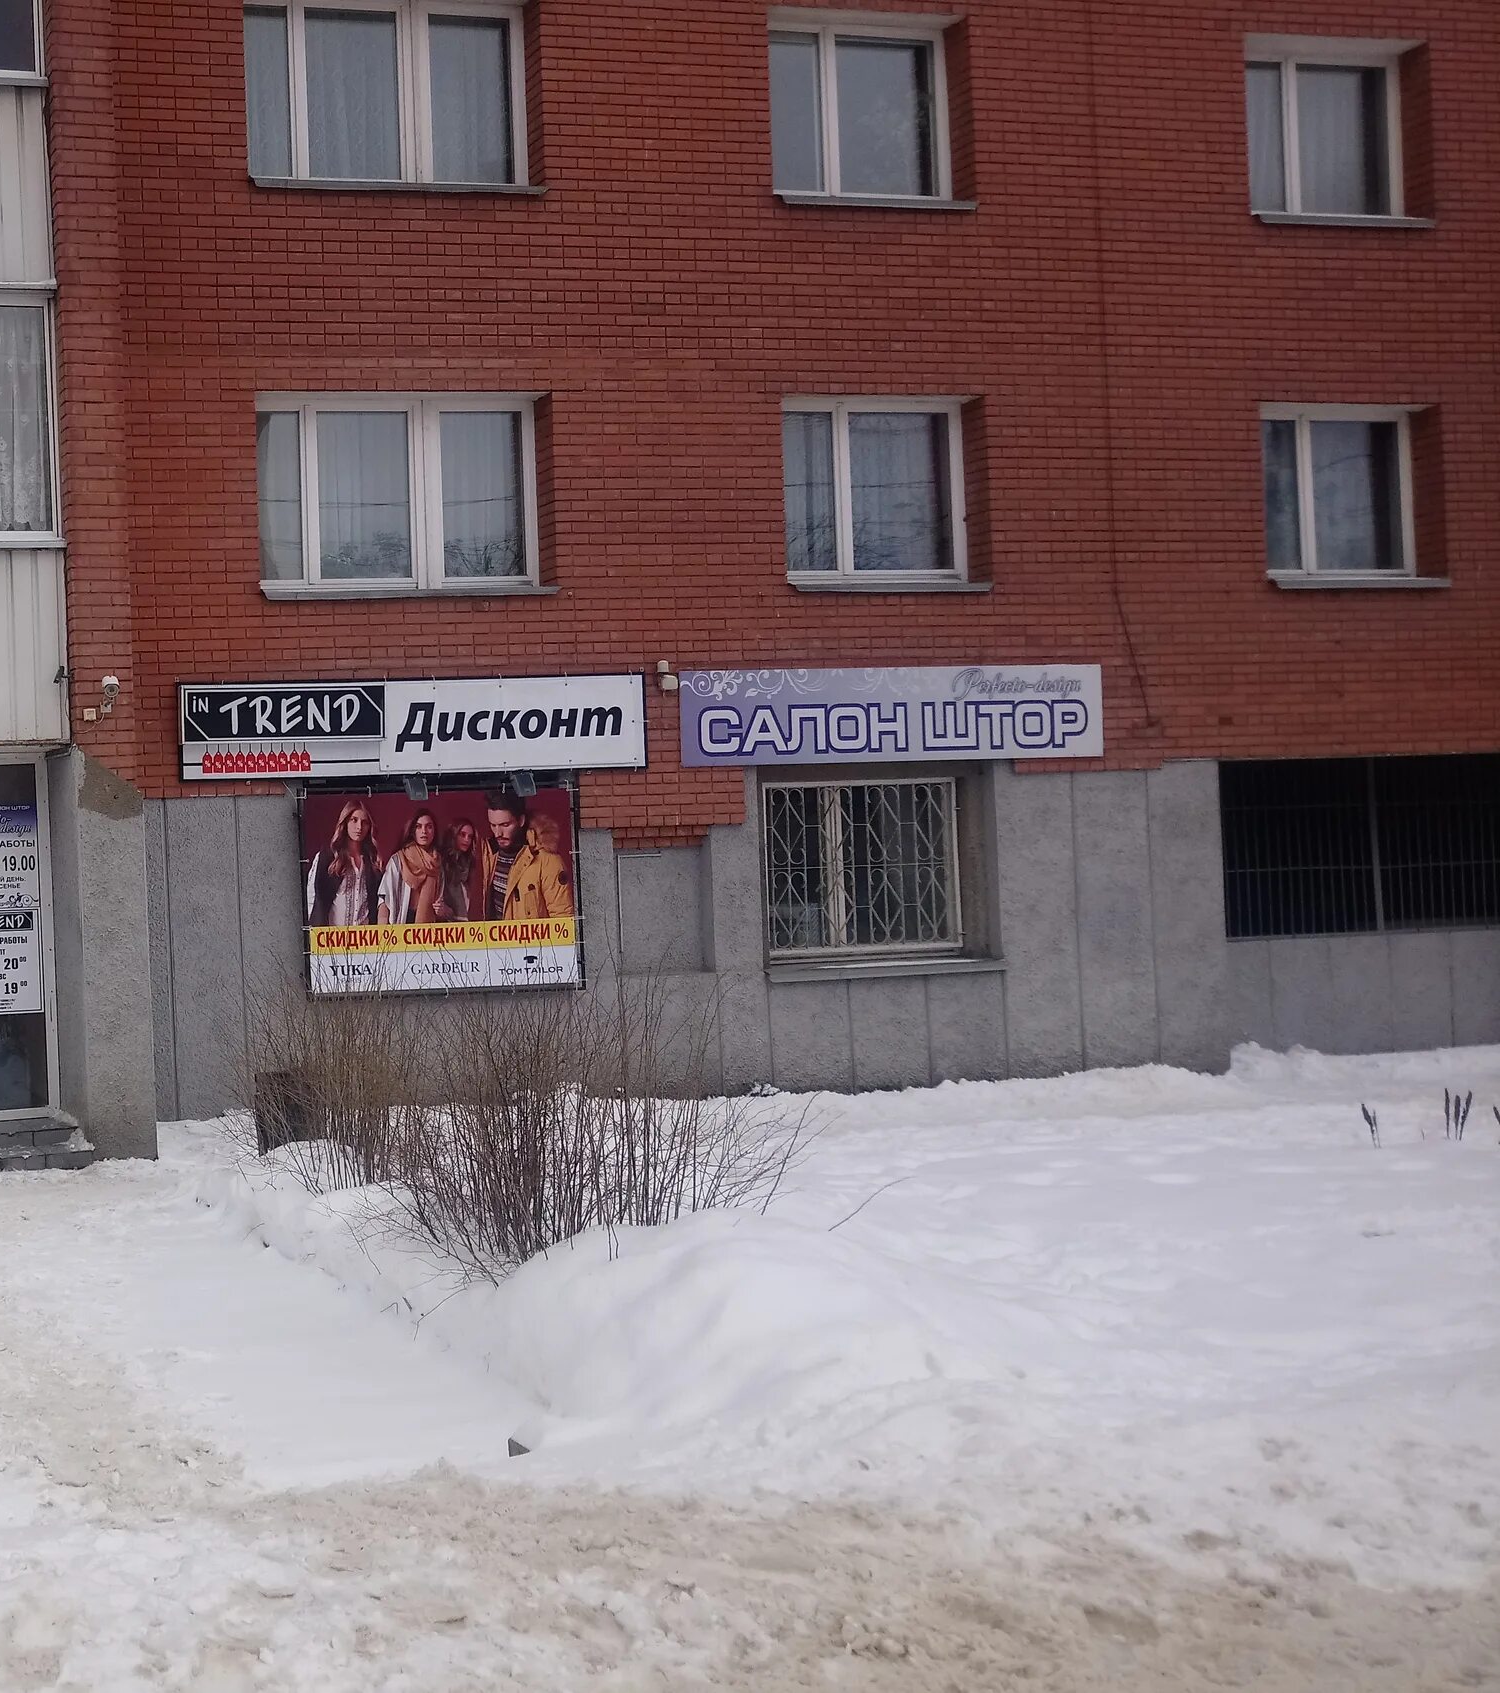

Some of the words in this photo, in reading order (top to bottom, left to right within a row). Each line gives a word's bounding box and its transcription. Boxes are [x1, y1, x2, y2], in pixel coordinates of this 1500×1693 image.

[219, 693, 361, 735] TREND
[395, 701, 623, 753] Дисконт
[699, 701, 908, 757] САЛОН
[923, 699, 1088, 752] ШТОР
[0, 821, 31, 837] design
[2, 855, 36, 871] 19.00
[0, 936, 27, 944] РАБОТЫ
[317, 930, 379, 949] СКИДКИ
[403, 927, 465, 946] СКИДКИ
[489, 924, 550, 943] СКИДКИ
[329, 964, 373, 976] YUKA
[411, 961, 480, 975] GARDEUR
[524, 966, 563, 974] TAILOR
